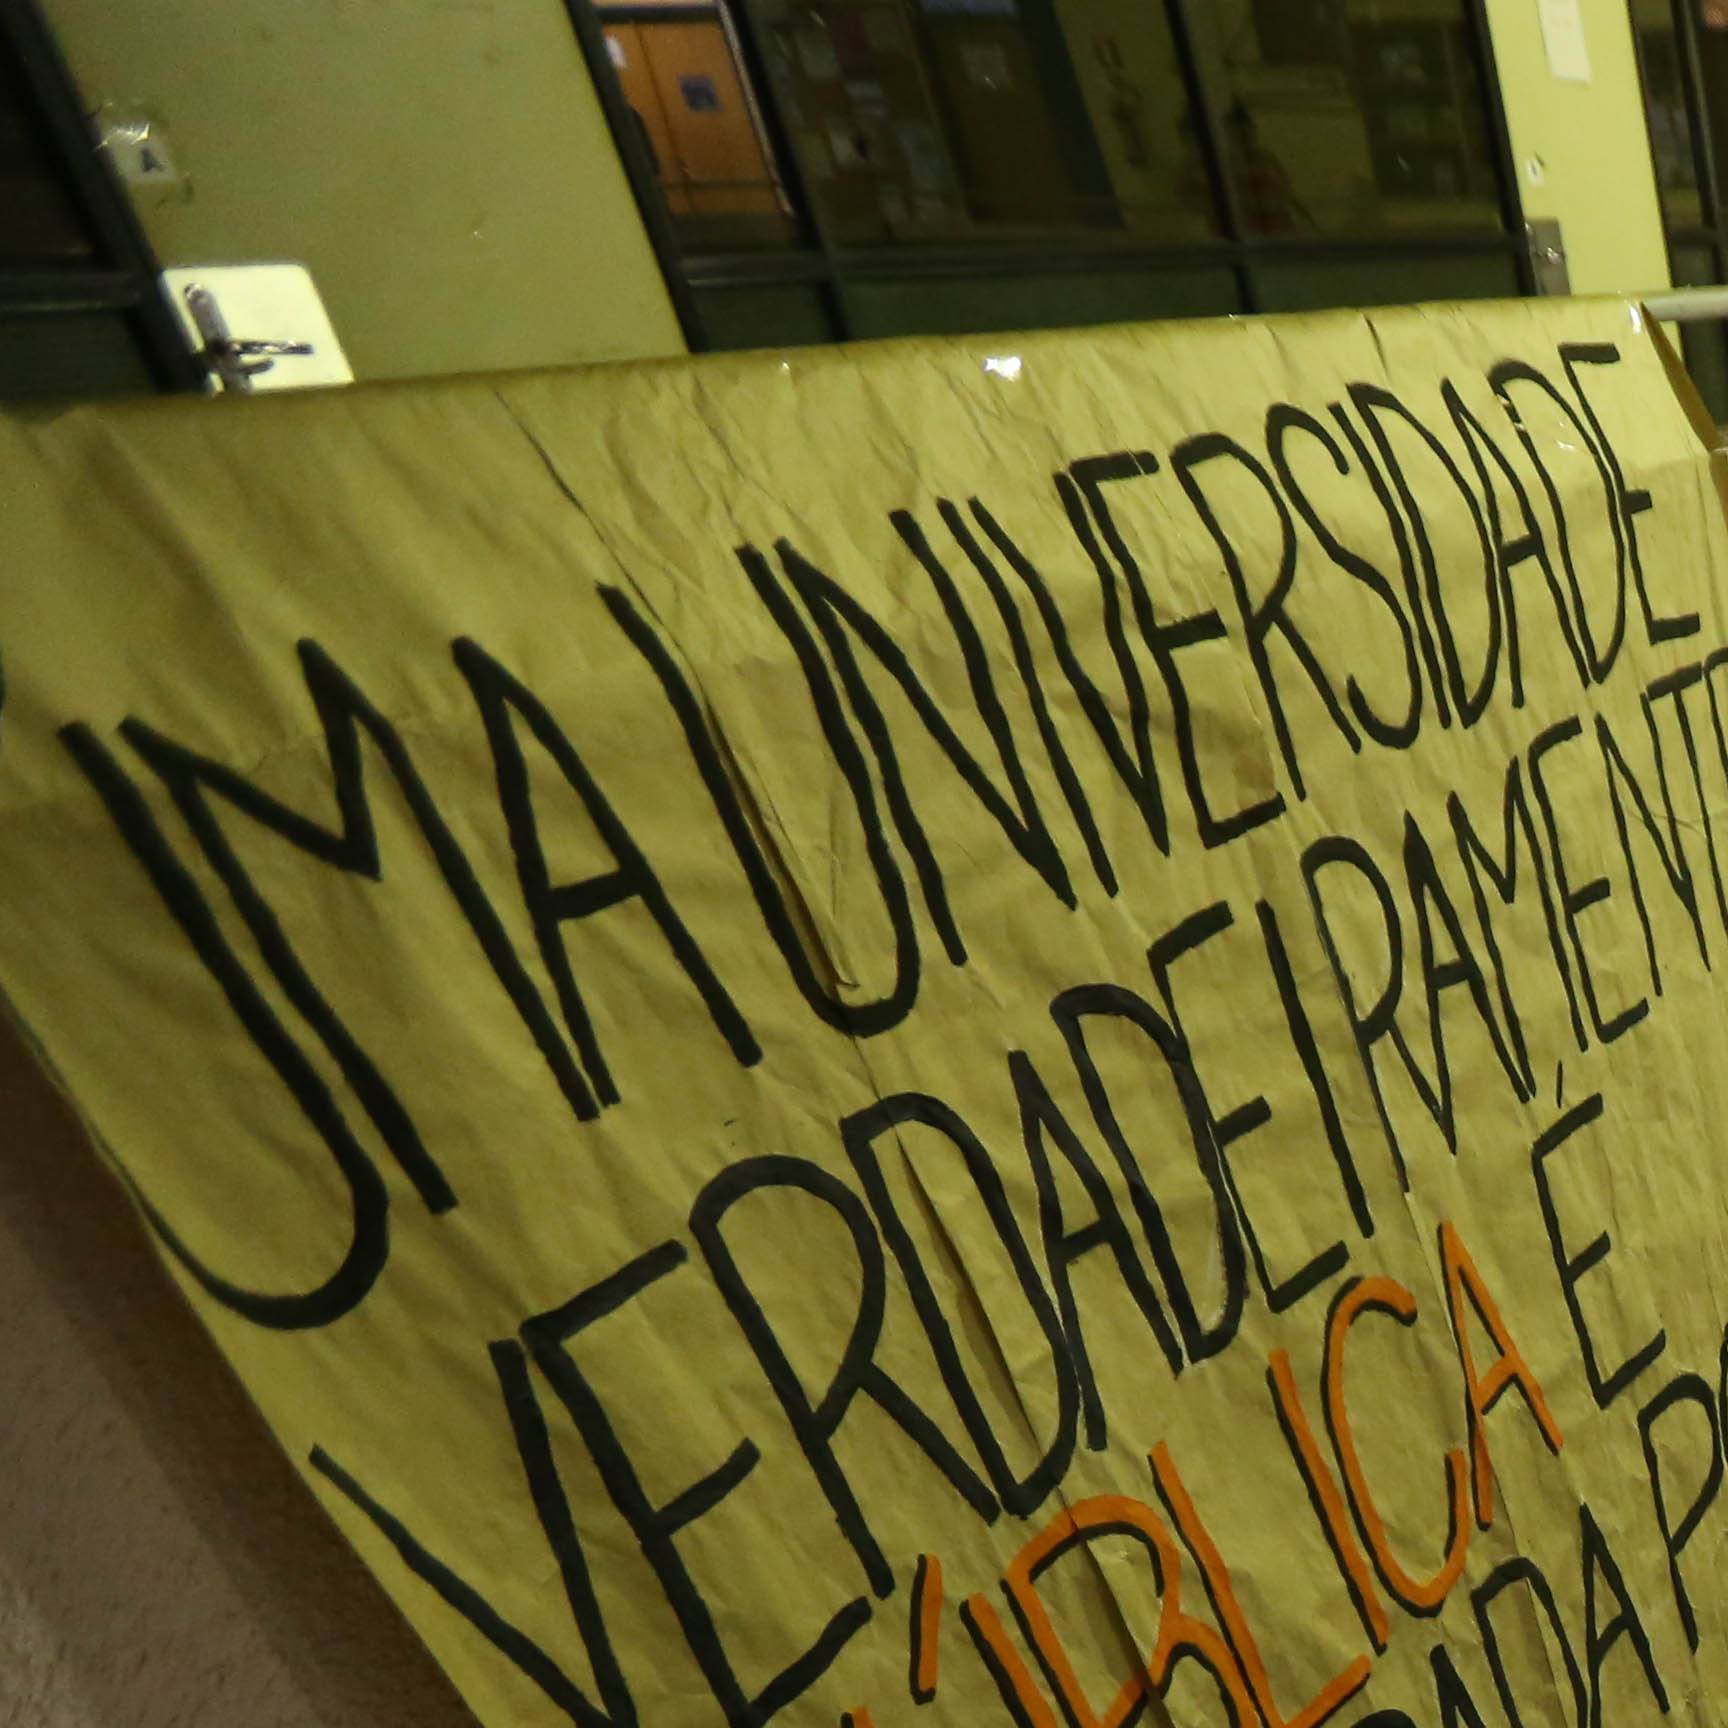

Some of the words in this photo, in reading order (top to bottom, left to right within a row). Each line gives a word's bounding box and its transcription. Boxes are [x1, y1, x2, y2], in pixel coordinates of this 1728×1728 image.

[0, 585, 762, 1330] UMA
[735, 343, 1701, 1039] UNIVERSIDADE
[1530, 1055, 1671, 1412] É
